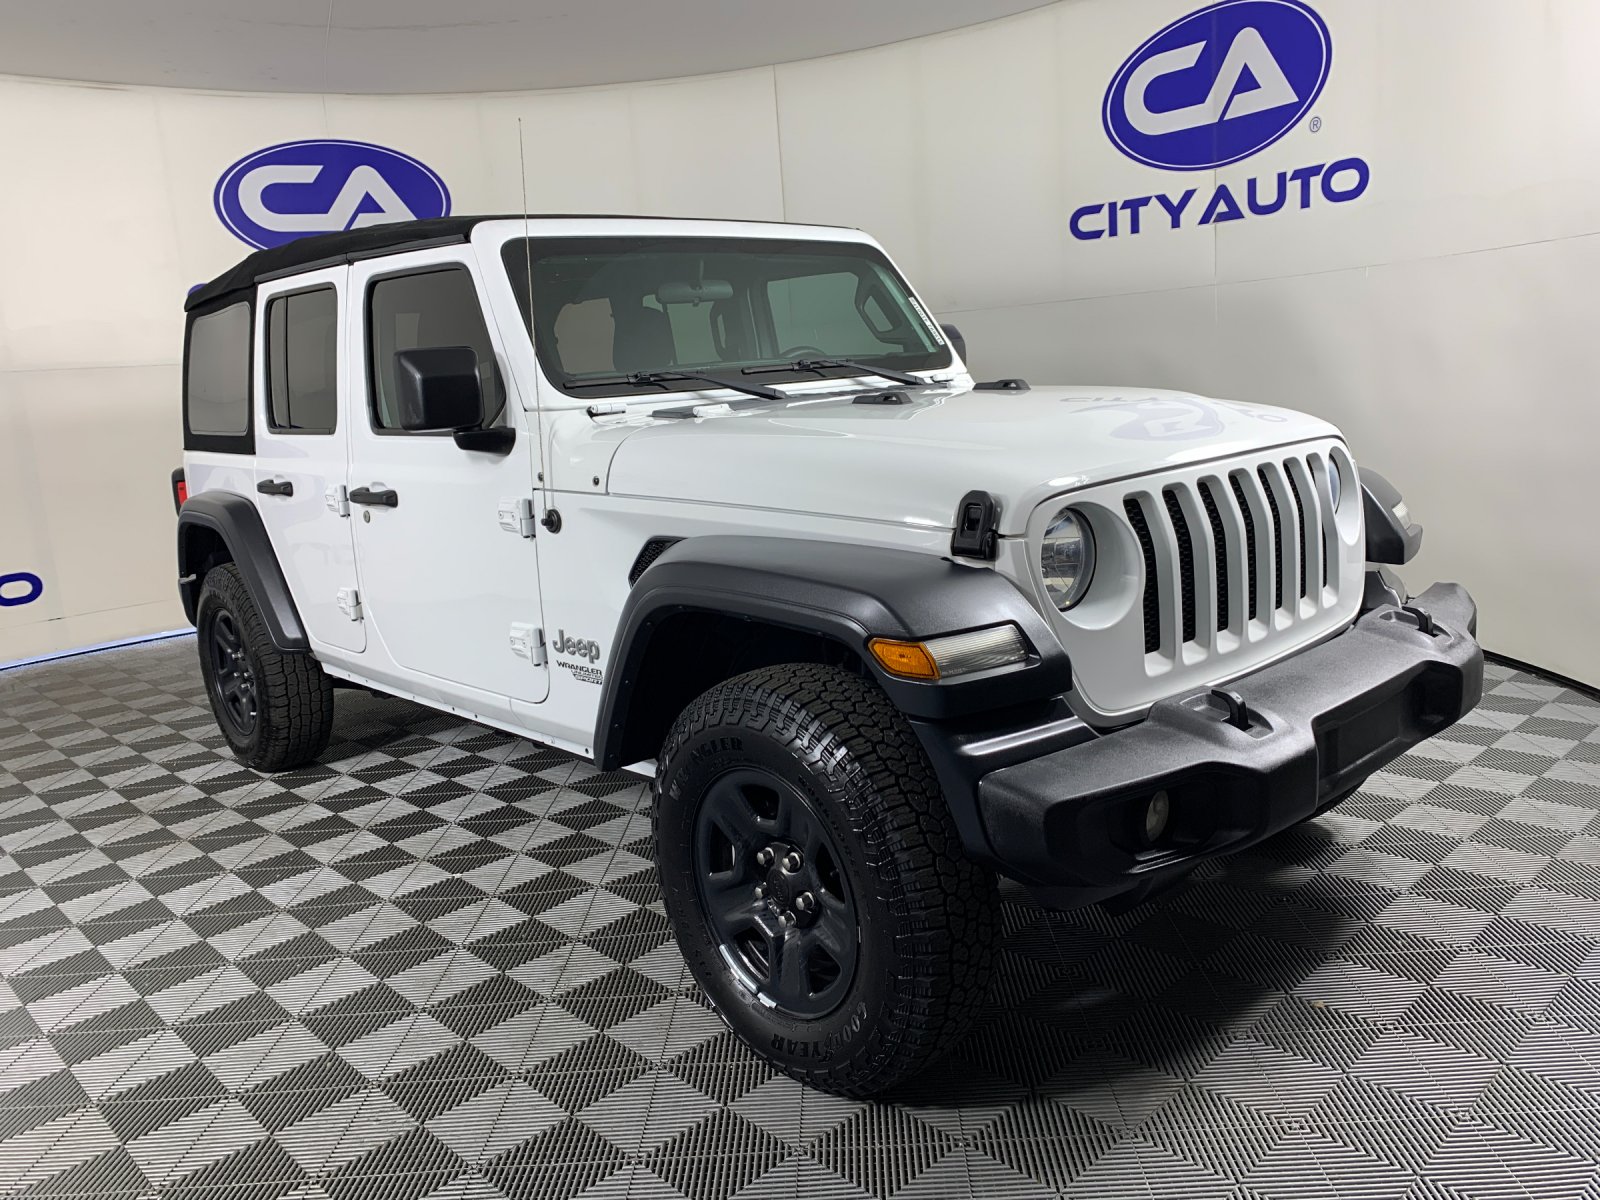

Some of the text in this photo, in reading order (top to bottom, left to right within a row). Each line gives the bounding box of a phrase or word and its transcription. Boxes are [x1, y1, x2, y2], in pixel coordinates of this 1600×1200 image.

[1123, 26, 1300, 136] CA
[238, 164, 418, 232] CA
[1069, 157, 1370, 241] CITY AUTO
[552, 629, 601, 664] Jeep
[556, 660, 603, 676] WRANGLER
[770, 1001, 867, 1059] GOODYEAR
